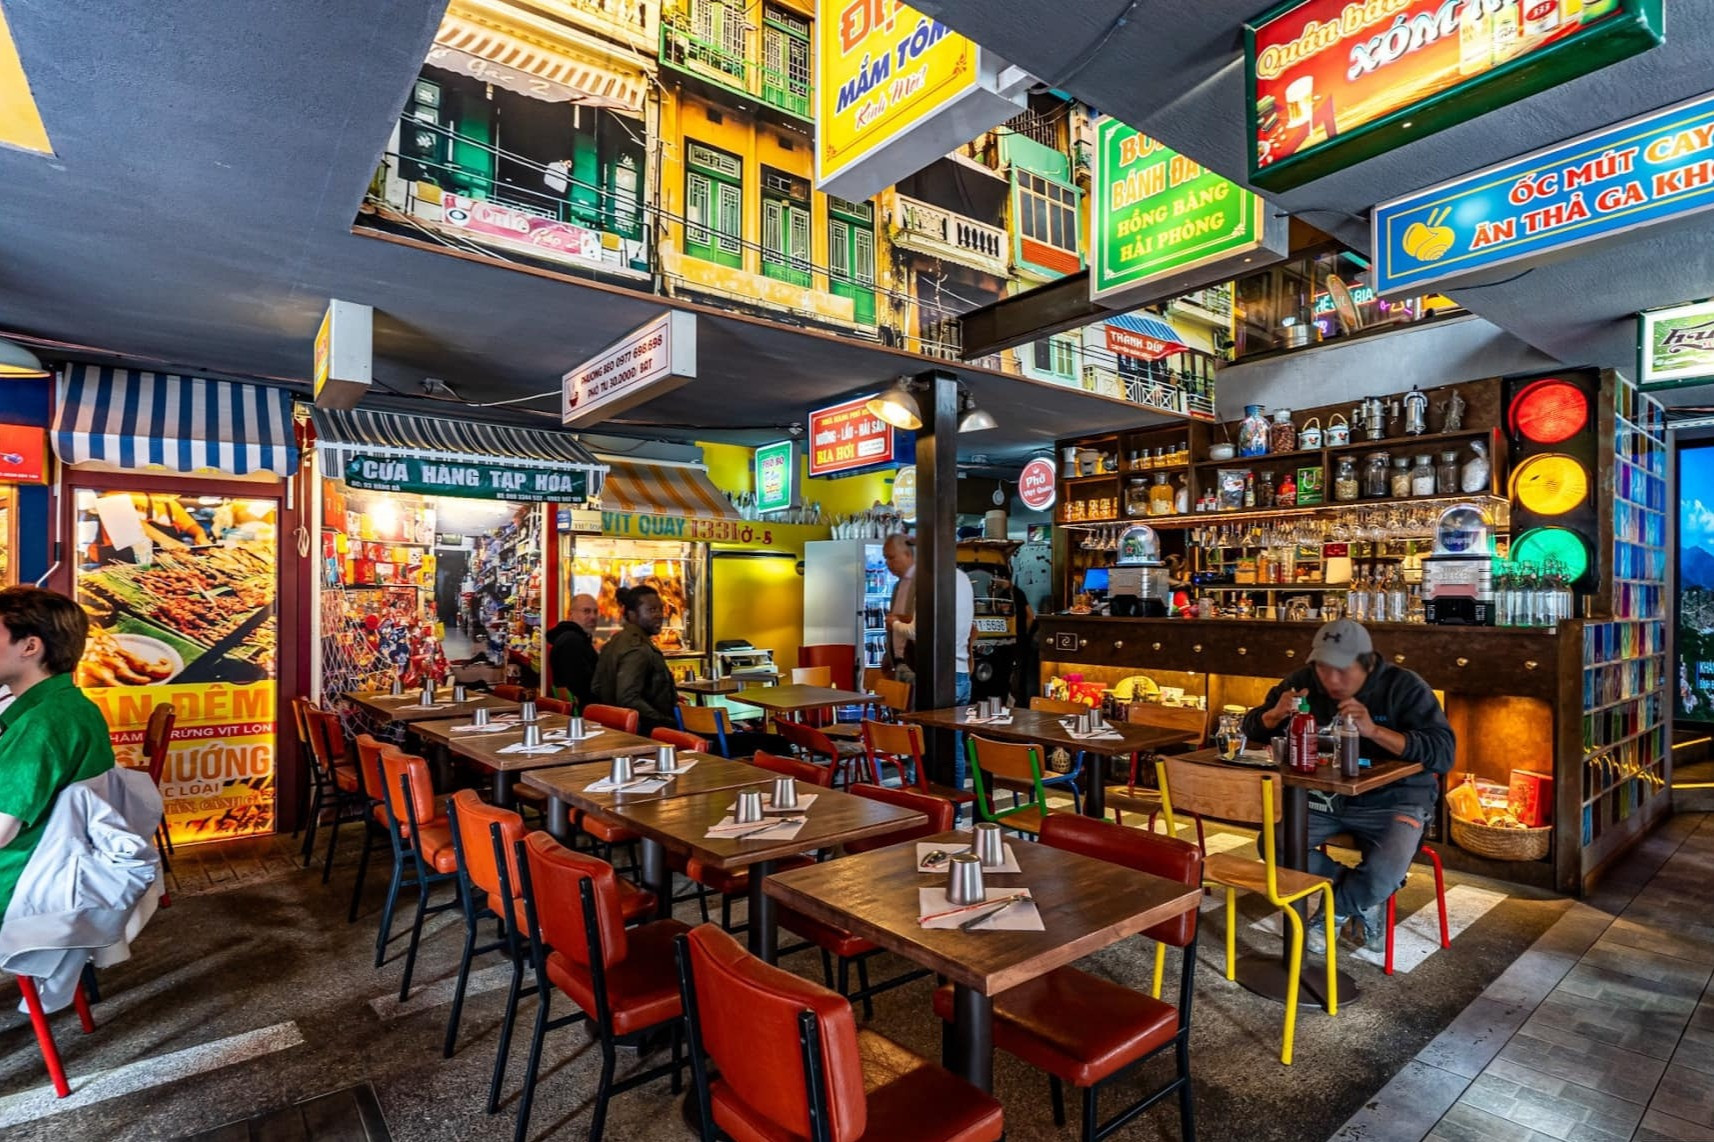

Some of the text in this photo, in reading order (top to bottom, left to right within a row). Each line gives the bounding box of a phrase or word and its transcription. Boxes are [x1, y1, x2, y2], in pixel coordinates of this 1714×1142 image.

[1258, 22, 1339, 77] Quán
[1510, 124, 1714, 204] ỐC MÚT CAY
[1111, 161, 1166, 212] BÁNH
[1471, 219, 1516, 250] ĂN
[1522, 192, 1590, 233] THẢ
[1597, 182, 1645, 212] GA
[1119, 212, 1225, 262] HẢI PHÒNG
[816, 448, 834, 465] BIA
[422, 463, 479, 487] HÀNG
[490, 470, 526, 492] TẠP
[535, 470, 573, 492] HÓA
[602, 511, 632, 536] VỊT
[638, 514, 685, 537] QUAY
[171, 684, 270, 722] ĐÊM
[170, 725, 214, 740] RỨNG
[217, 725, 241, 738] VỊT
[180, 782, 219, 797] LOẠI
